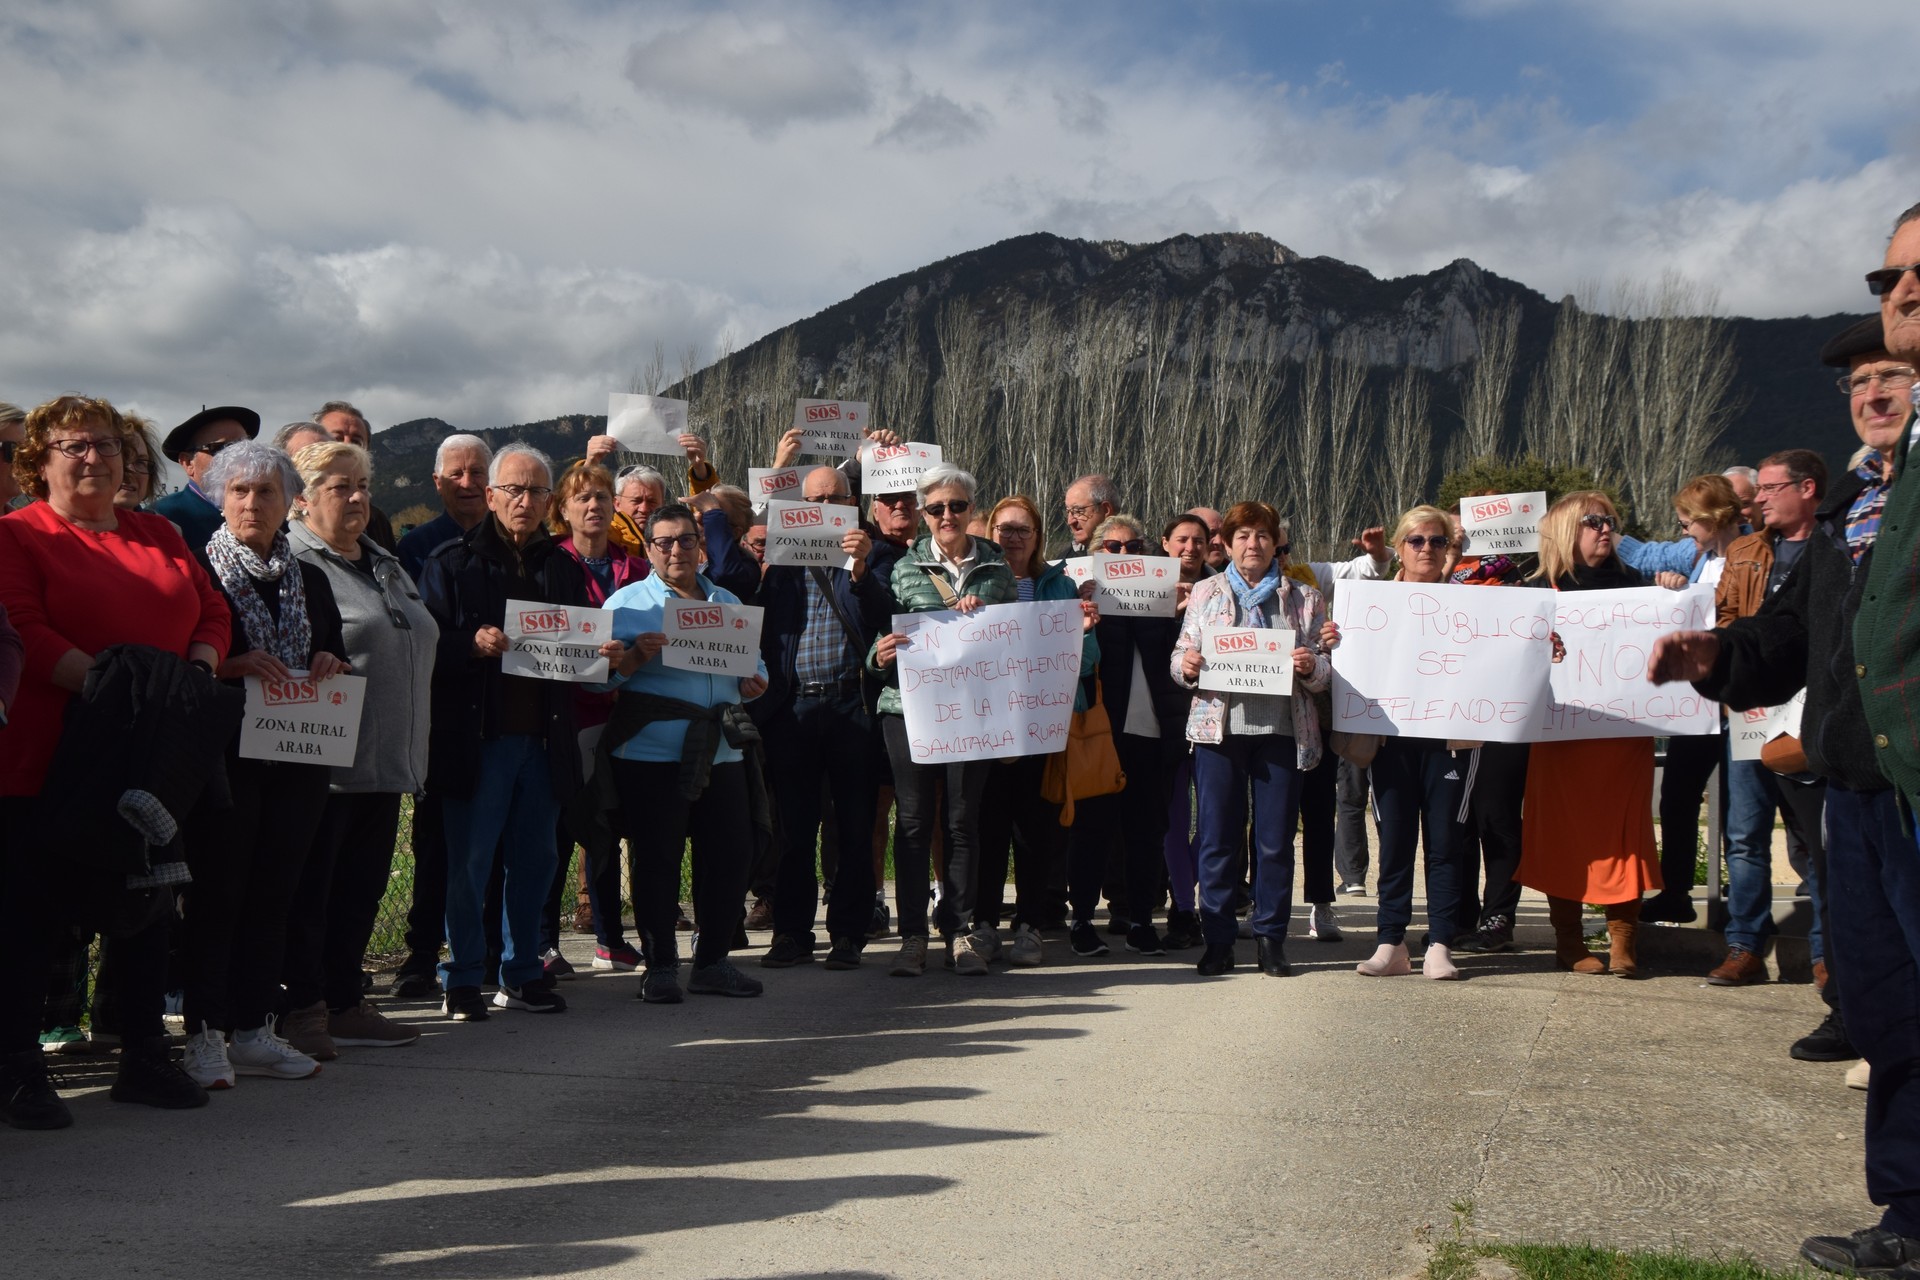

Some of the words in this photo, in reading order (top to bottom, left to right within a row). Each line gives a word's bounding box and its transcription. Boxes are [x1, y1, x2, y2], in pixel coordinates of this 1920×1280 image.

[808, 406, 839, 420] SOS
[801, 430, 828, 439] ZONA
[830, 431, 861, 440] RURAL
[814, 442, 846, 451] ARABA
[877, 445, 908, 459] SOS
[871, 469, 898, 477] ZONA
[901, 466, 927, 474] RURA
[764, 473, 798, 491] SOS
[887, 478, 919, 488] ARABA
[1475, 501, 1509, 519] SOS
[784, 510, 820, 526] SOS
[1470, 529, 1500, 537] ZONA
[1503, 525, 1538, 535] RURAL
[776, 537, 807, 547] ZONA
[810, 539, 841, 548] RURA
[1488, 540, 1523, 549] ARABA
[792, 552, 828, 560] ARABA
[1109, 561, 1142, 576] SOS
[1101, 587, 1130, 597] ZONA
[1133, 589, 1169, 599] RURAL
[1116, 602, 1151, 611] ARABA
[1343, 591, 1388, 631] LO
[525, 612, 566, 631] SOS
[681, 610, 720, 626] SOS
[958, 619, 1022, 645] CONTRA
[1039, 612, 1077, 636] DEL
[671, 638, 704, 650] ZONA
[708, 642, 749, 655] RURAL
[1219, 635, 1254, 650] SOS
[514, 643, 551, 655] ZONA
[555, 647, 598, 659] RURAL
[533, 661, 577, 674] ARABA
[688, 656, 728, 668] ARABA
[1210, 662, 1241, 672] ZONA
[1245, 664, 1283, 674] RURAL
[1416, 650, 1466, 675] SE
[1578, 643, 1646, 686] NO
[1227, 678, 1264, 688] ARABA
[267, 681, 315, 701] SOS
[935, 702, 963, 723] DE
[973, 698, 992, 717] LA
[1542, 695, 1714, 730] MPOSICION
[255, 717, 296, 733] ZONA
[300, 722, 347, 737] RURAL
[1028, 719, 1068, 744] RURAL
[1741, 731, 1767, 740] ZON
[275, 741, 322, 755] ARABA
